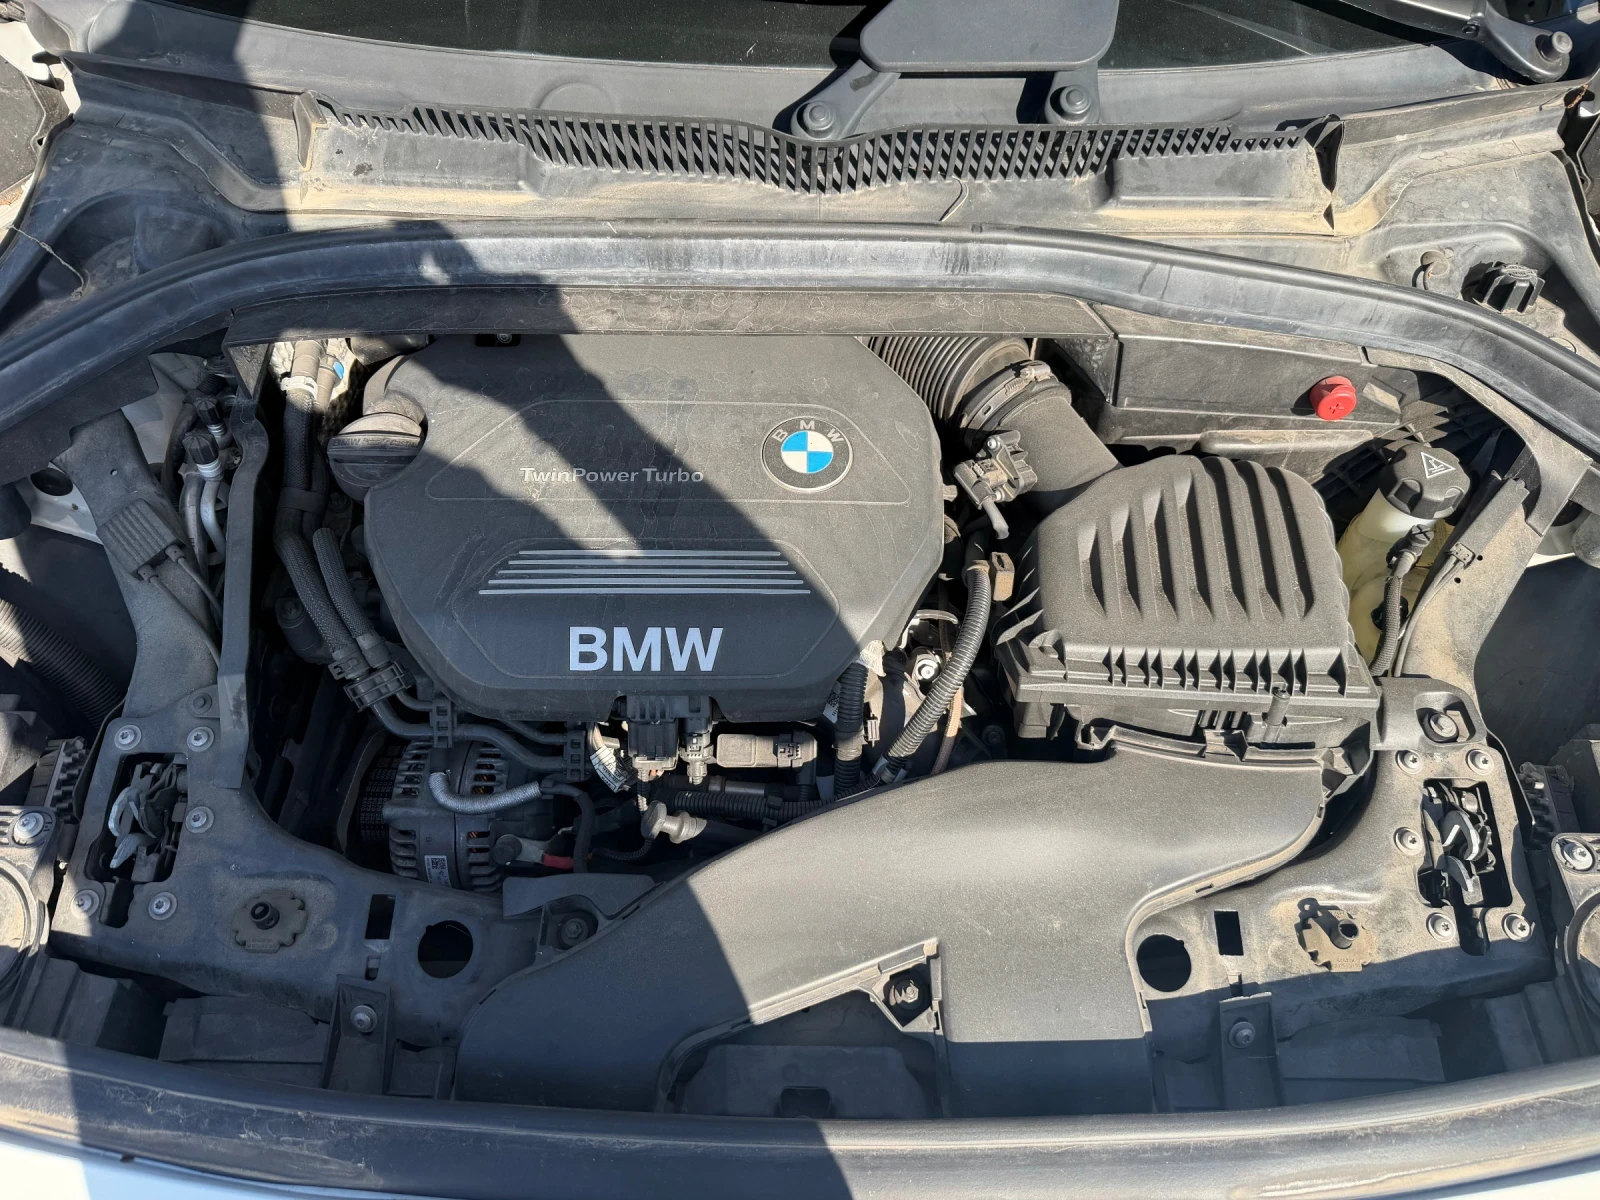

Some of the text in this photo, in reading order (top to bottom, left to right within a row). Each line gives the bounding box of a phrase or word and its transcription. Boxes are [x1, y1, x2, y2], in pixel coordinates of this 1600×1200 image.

[772, 419, 845, 443] BMW
[332, 437, 361, 447] BMW
[519, 467, 704, 482] TwinPower Turbo
[569, 626, 724, 672] BMW
